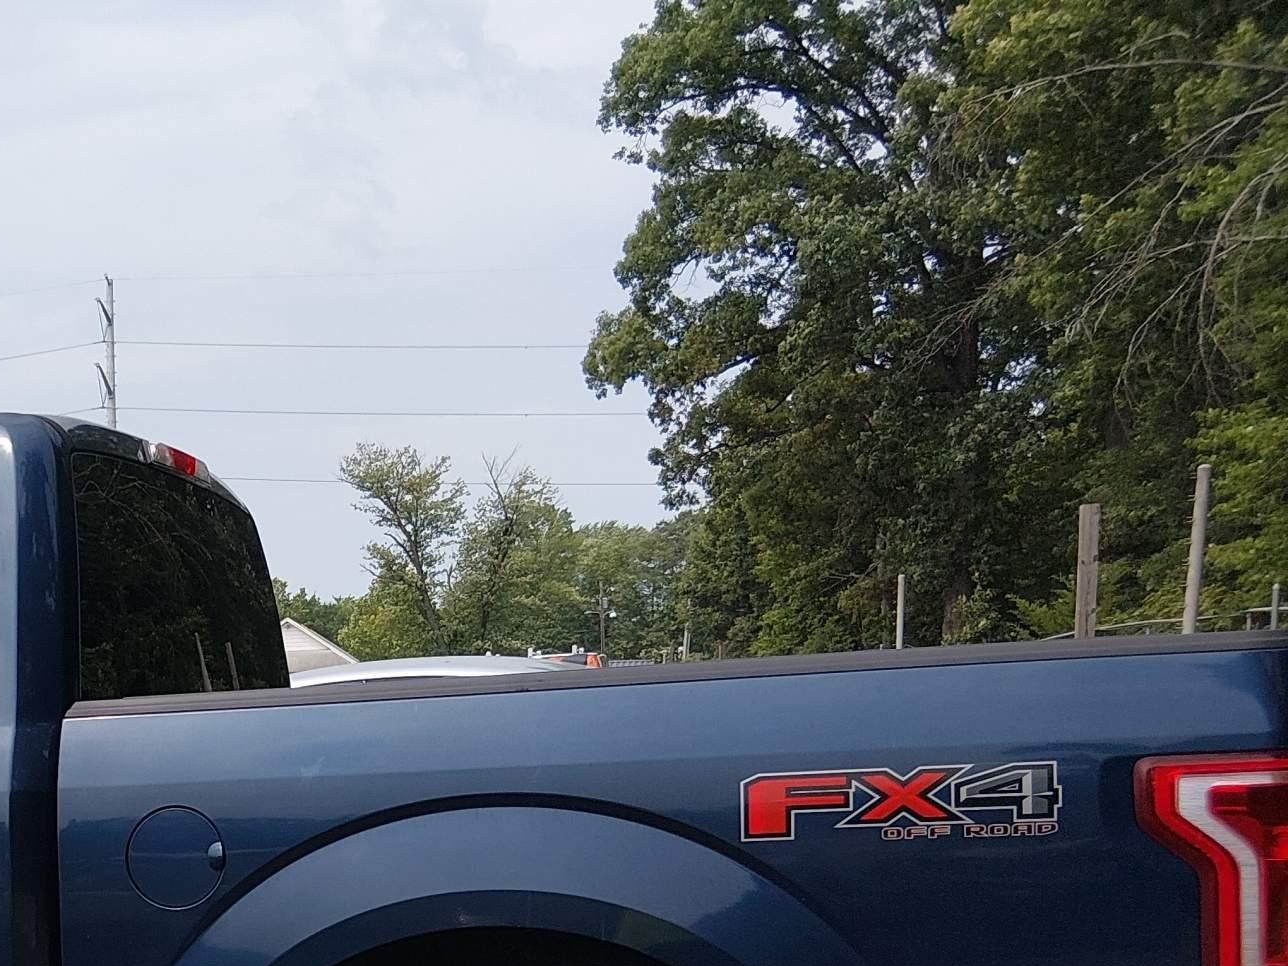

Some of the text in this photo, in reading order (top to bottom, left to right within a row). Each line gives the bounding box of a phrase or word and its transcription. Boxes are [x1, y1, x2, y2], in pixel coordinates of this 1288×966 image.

[740, 761, 1062, 842] FX4
[881, 822, 1059, 840] OFF ROAD
